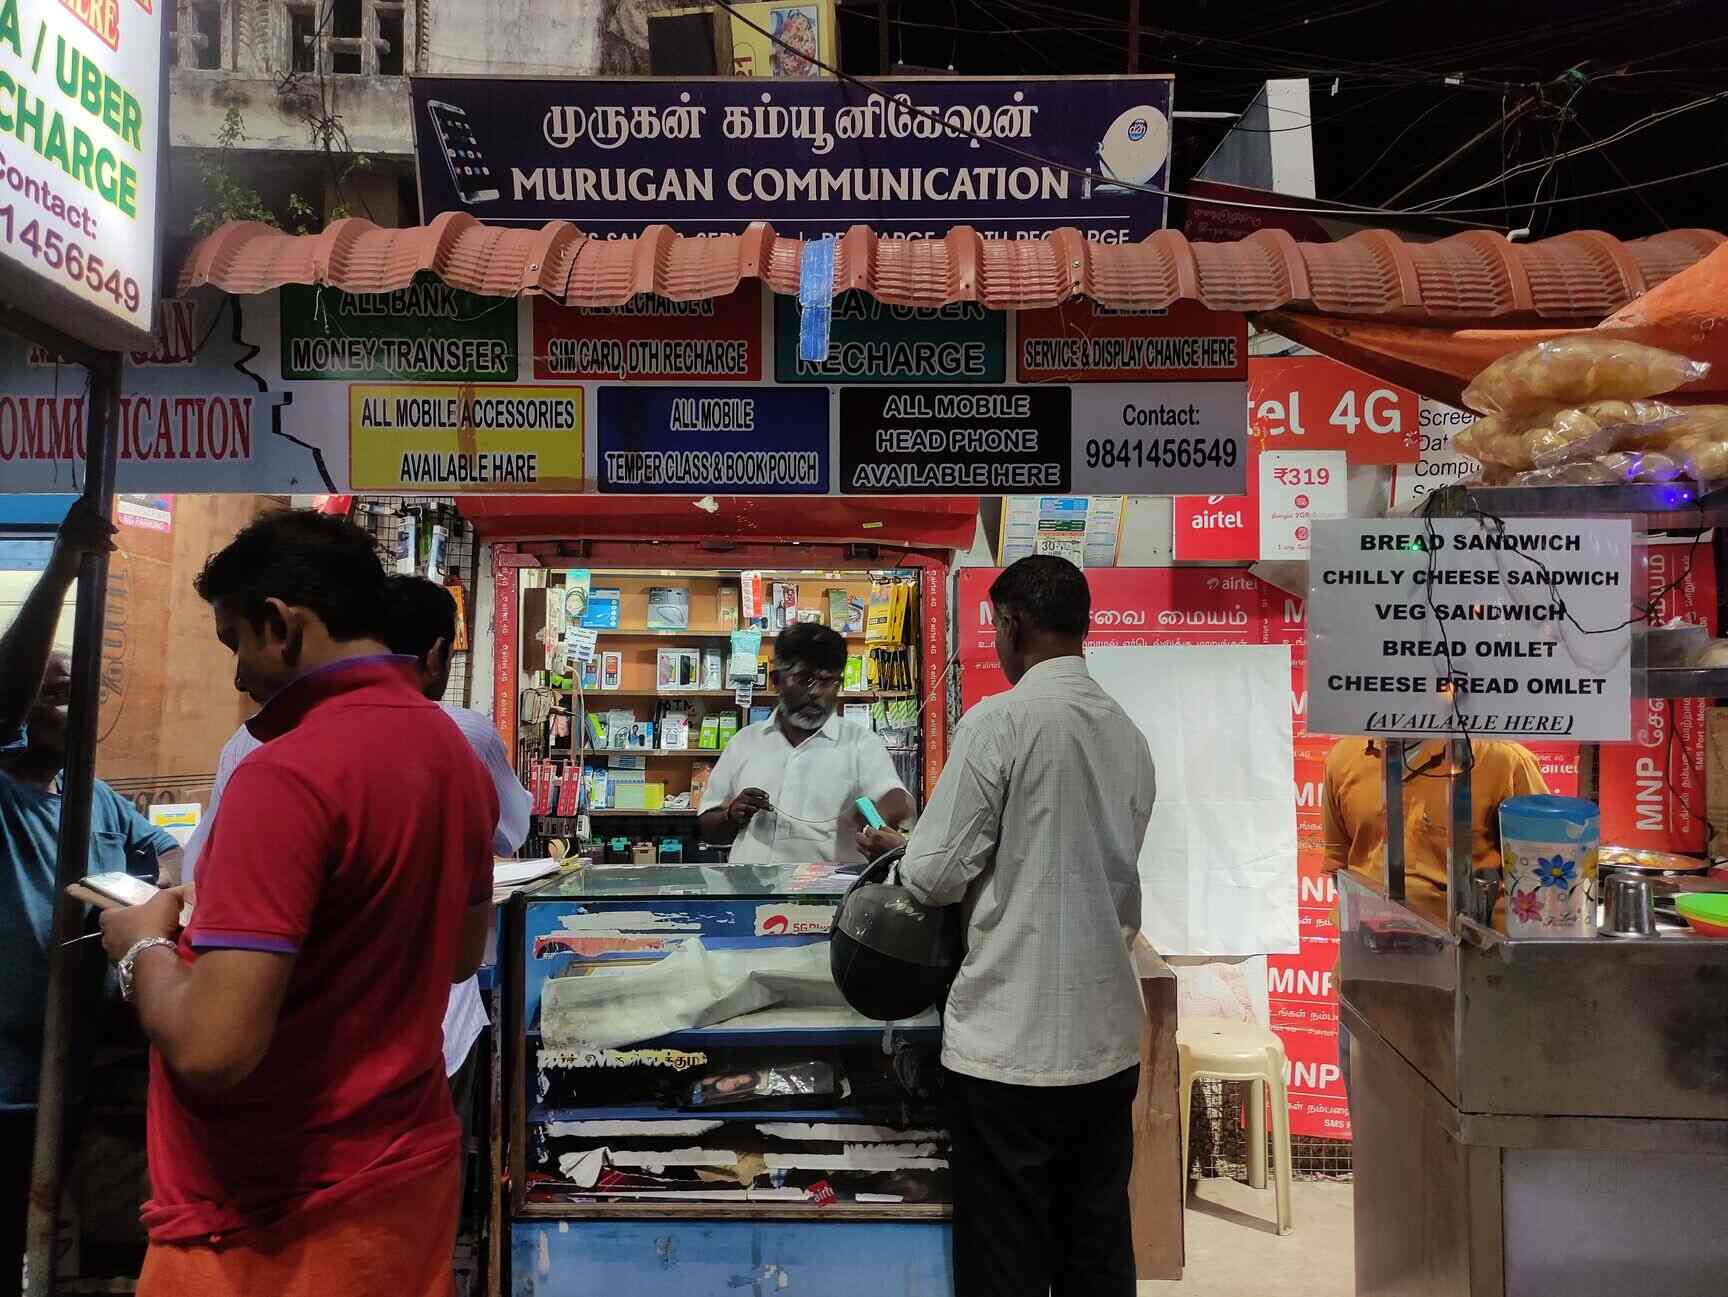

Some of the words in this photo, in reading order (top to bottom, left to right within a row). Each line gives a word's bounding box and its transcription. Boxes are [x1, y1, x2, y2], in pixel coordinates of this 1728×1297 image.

[56, 34, 143, 151] UBER
[543, 92, 706, 149] முருகன்
[722, 91, 1038, 154] கம்யூனிகேஷன்
[0, 153, 97, 240] ontact:
[511, 167, 714, 201] MURUGAN
[727, 167, 1068, 202] COMMUNICATION
[391, 283, 458, 316] BANK
[291, 338, 378, 371] MONEY
[379, 338, 508, 373] TRANSFER
[548, 338, 576, 374] SIM
[577, 339, 626, 381] CARD,
[627, 339, 662, 374] DTH
[662, 339, 749, 375] RECHARGE
[1023, 338, 1079, 369] SERVICE
[1080, 338, 1091, 369] &
[1092, 337, 1146, 369] DISPLAY
[1147, 337, 1200, 369] CHANGE
[1200, 336, 1238, 368] HERE
[361, 398, 391, 427] ALL
[396, 398, 457, 428] MOBILE
[460, 399, 575, 429] ACCESSORIES
[671, 399, 699, 431] ALL
[700, 399, 754, 431] MOBILE
[883, 395, 932, 417] ALL
[935, 394, 1031, 418] MOBILE
[1122, 404, 1200, 426] Contact:
[1329, 388, 1401, 434] 4G
[876, 429, 946, 452] HEAD
[950, 429, 1038, 452] PHONE
[1085, 438, 1237, 469] 9841456549
[1419, 434, 1448, 452] Dat
[401, 453, 488, 482] AVAILABLE
[492, 454, 537, 482] HARE
[605, 451, 666, 483] TEMPER
[711, 453, 725, 484] &
[725, 452, 767, 484] BOOK
[767, 451, 819, 484] POUCH
[853, 464, 988, 487] AVAILABLE
[991, 463, 1062, 487] HERE
[1273, 467, 1330, 486] ₹319
[1191, 510, 1243, 528] airtel
[1360, 534, 1444, 551] BREAD
[1453, 534, 1580, 551] SANDWICH
[1222, 576, 1257, 591] airtel
[1323, 570, 1404, 585] CHILLY
[1413, 570, 1500, 586] CHEESE
[1507, 570, 1619, 586] SANDWICH
[1375, 604, 1426, 620] VEG
[1436, 604, 1566, 621] SANDWICH
[1383, 640, 1466, 657] BREAD
[1475, 641, 1557, 658] OMLET
[1327, 675, 1426, 693] CHEESE
[1436, 677, 1519, 694] BREAD
[1527, 678, 1607, 695] OMLET
[1504, 715, 1574, 735] HERE)
[1635, 756, 1665, 832] MNP
